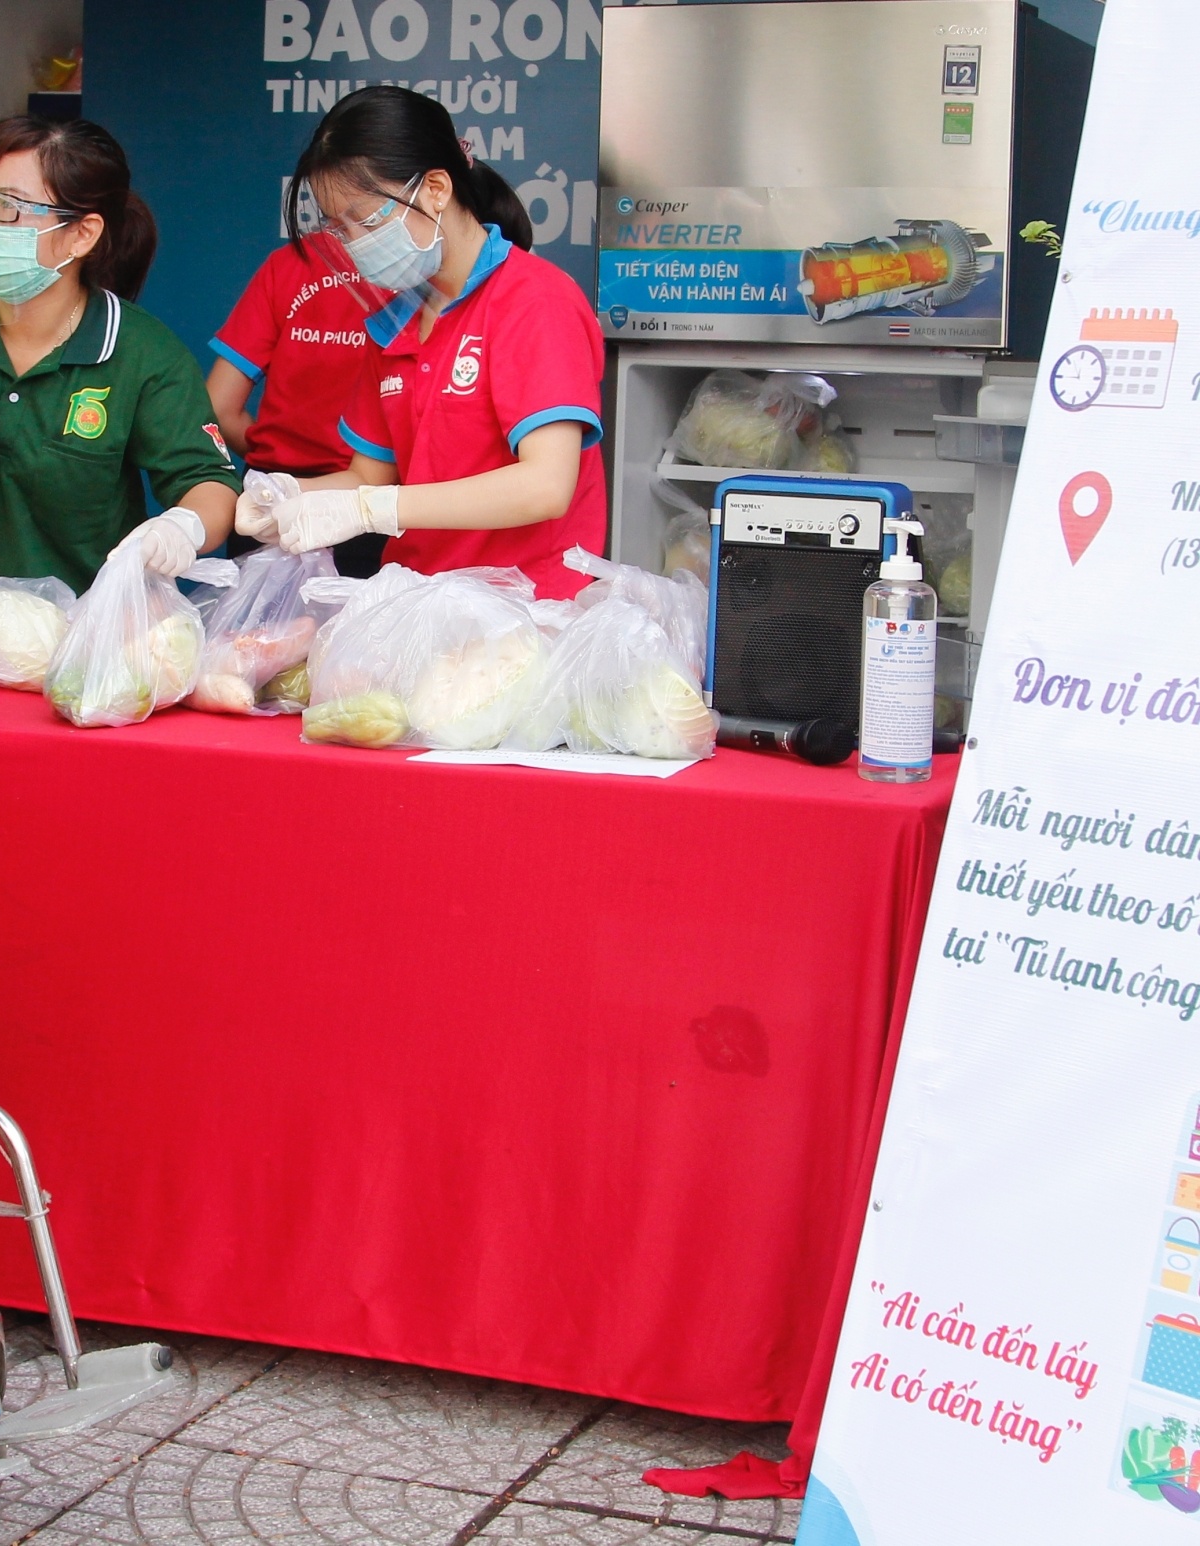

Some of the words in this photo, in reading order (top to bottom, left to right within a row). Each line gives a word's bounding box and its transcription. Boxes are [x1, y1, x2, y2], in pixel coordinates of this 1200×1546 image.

[263, 0, 430, 63] BAO
[951, 65, 972, 84] 12
[456, 126, 525, 161] AM
[635, 198, 690, 217] Casper
[616, 224, 743, 245] INVERTER
[615, 258, 651, 278] TIẾT
[654, 261, 695, 281] KIỆM
[699, 260, 739, 281] ĐIỆN
[648, 282, 683, 303] VẬN
[687, 283, 736, 301] HÀNH
[740, 283, 765, 302] ÊM
[769, 284, 787, 302] ÁI
[290, 327, 320, 343] HOA
[914, 327, 936, 336] MADE
[939, 328, 947, 336] IN
[949, 328, 988, 337] THAILAND
[1012, 657, 1094, 712] Đơn
[1100, 672, 1143, 726] vị
[972, 785, 1032, 832] Mỗi
[1039, 809, 1136, 851] người
[956, 859, 1028, 902] thiết
[1027, 868, 1084, 917] yếu
[1086, 883, 1156, 926] theo
[942, 926, 990, 968] tại
[1049, 947, 1124, 991] lạnh
[1126, 963, 1200, 1022] cộng
[922, 1302, 977, 1350] cần
[982, 1323, 1039, 1372] đến
[1043, 1341, 1099, 1400] lấy
[850, 1352, 887, 1392] Ai
[891, 1368, 928, 1404] có
[931, 1380, 983, 1427] đến
